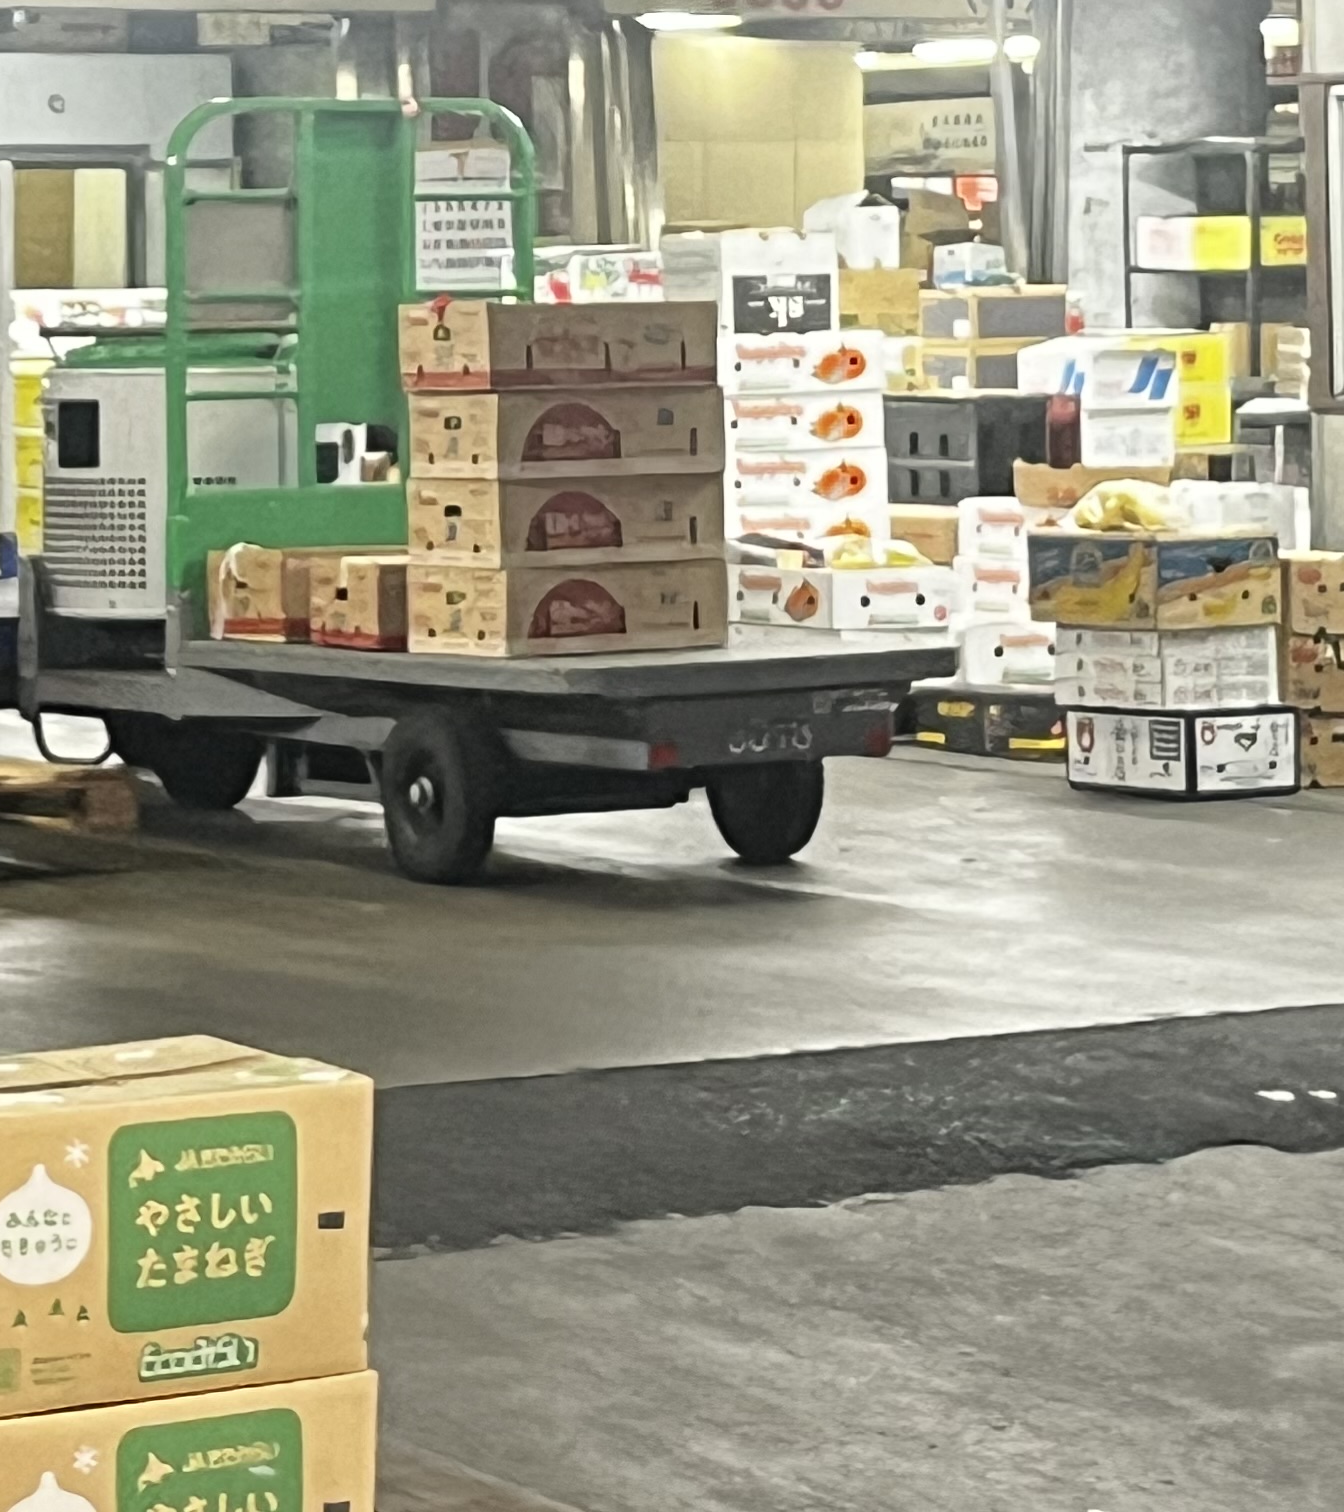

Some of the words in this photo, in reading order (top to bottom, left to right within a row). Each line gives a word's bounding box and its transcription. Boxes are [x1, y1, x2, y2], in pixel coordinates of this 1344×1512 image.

[134, 1192, 274, 1237] やさしい
[135, 1234, 277, 1289] たまねぎ
